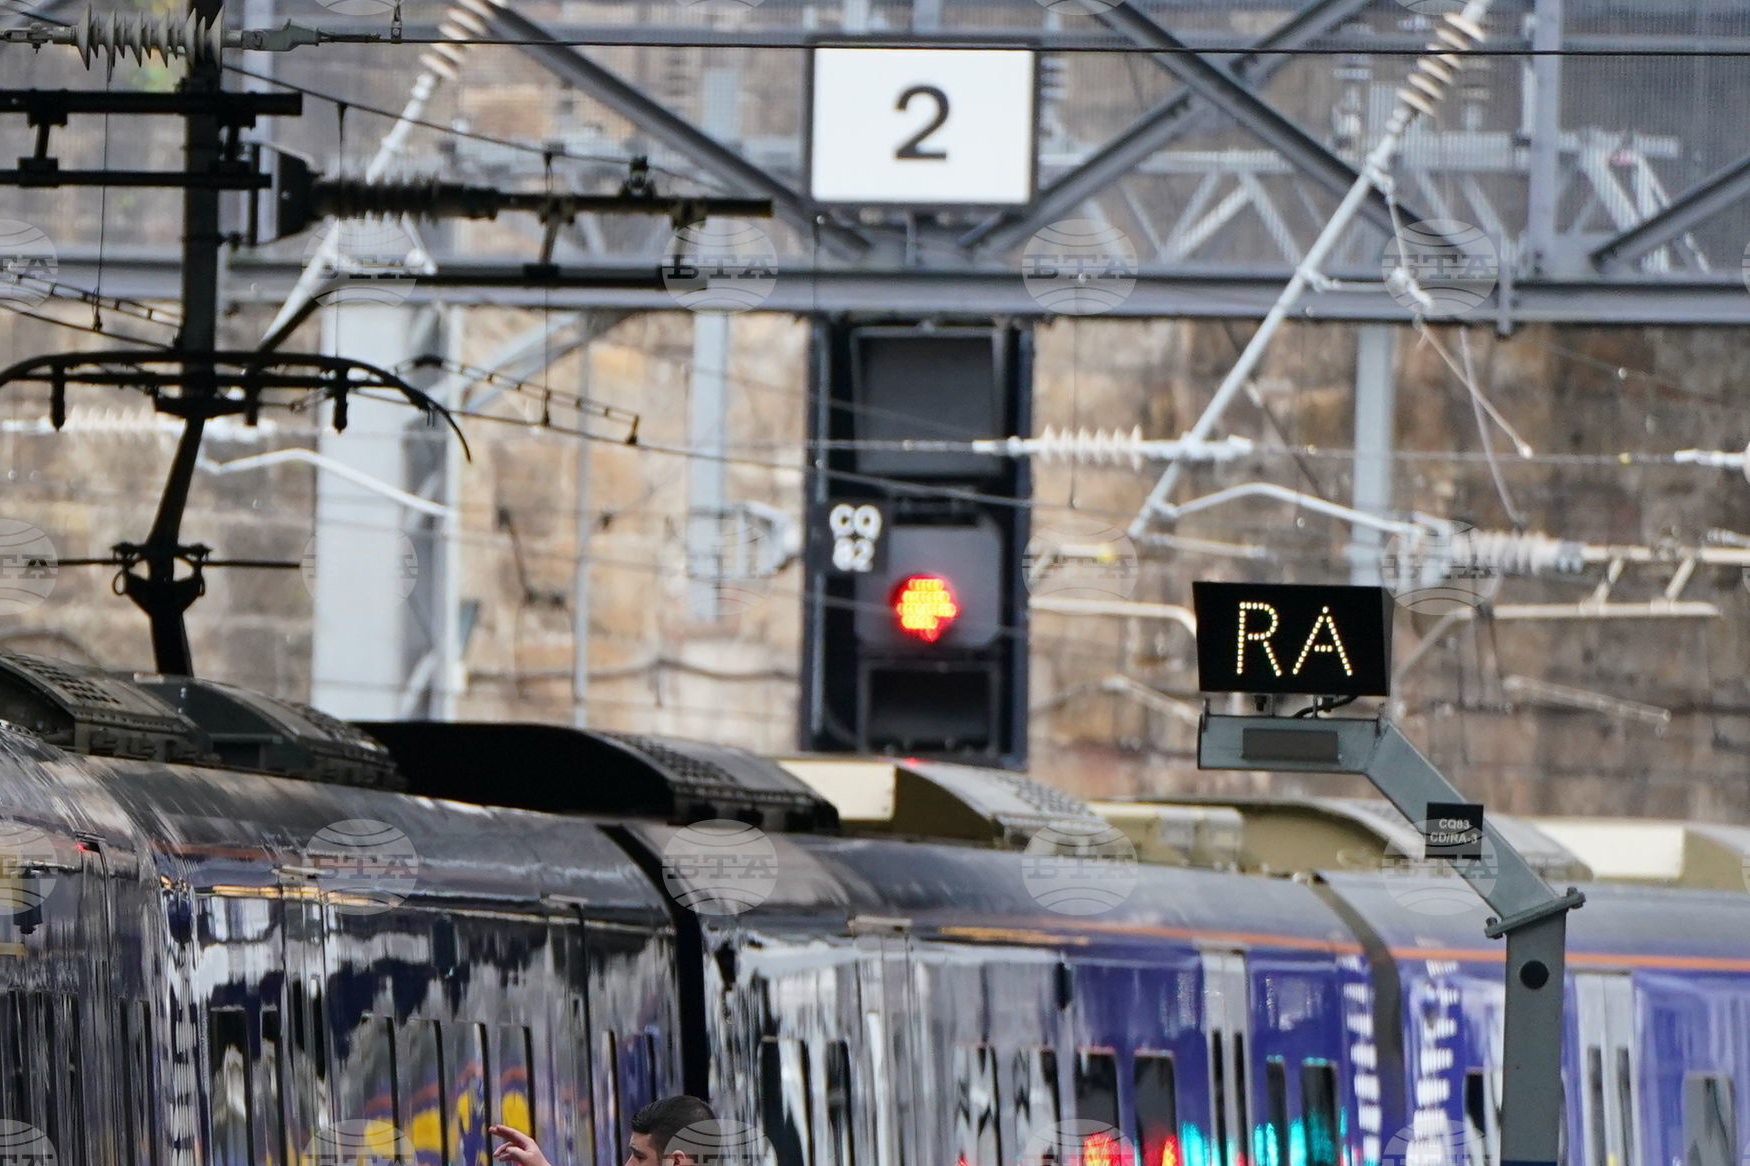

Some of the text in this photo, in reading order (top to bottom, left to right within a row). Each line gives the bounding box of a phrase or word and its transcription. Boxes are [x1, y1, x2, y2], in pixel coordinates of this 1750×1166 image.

[892, 86, 952, 161] 2
[1235, 601, 1354, 678] RA
[1438, 818, 1471, 830] CQ83
